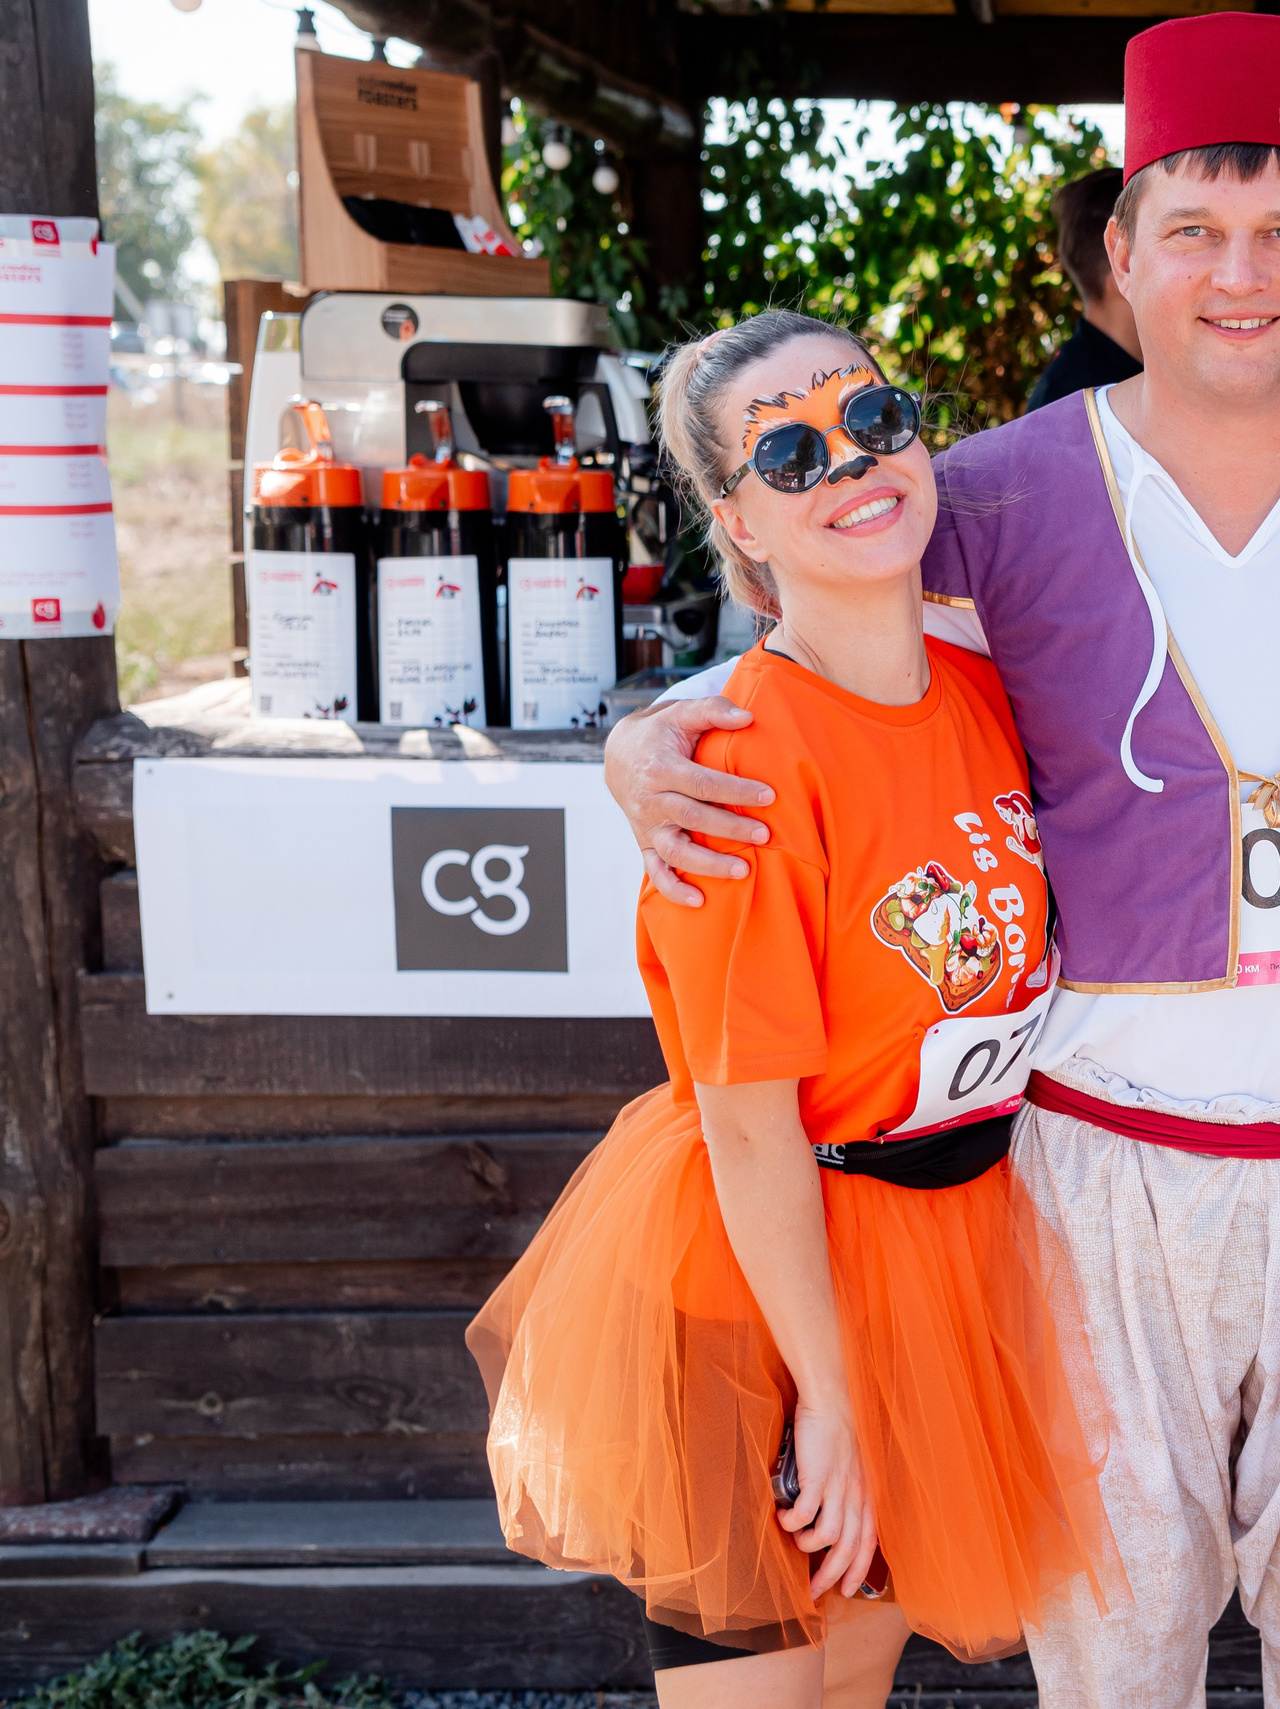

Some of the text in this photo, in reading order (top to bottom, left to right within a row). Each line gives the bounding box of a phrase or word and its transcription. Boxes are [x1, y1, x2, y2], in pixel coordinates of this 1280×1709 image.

[953, 812, 999, 873] Lis
[421, 843, 531, 936] cg
[947, 1012, 1043, 1101] 07
